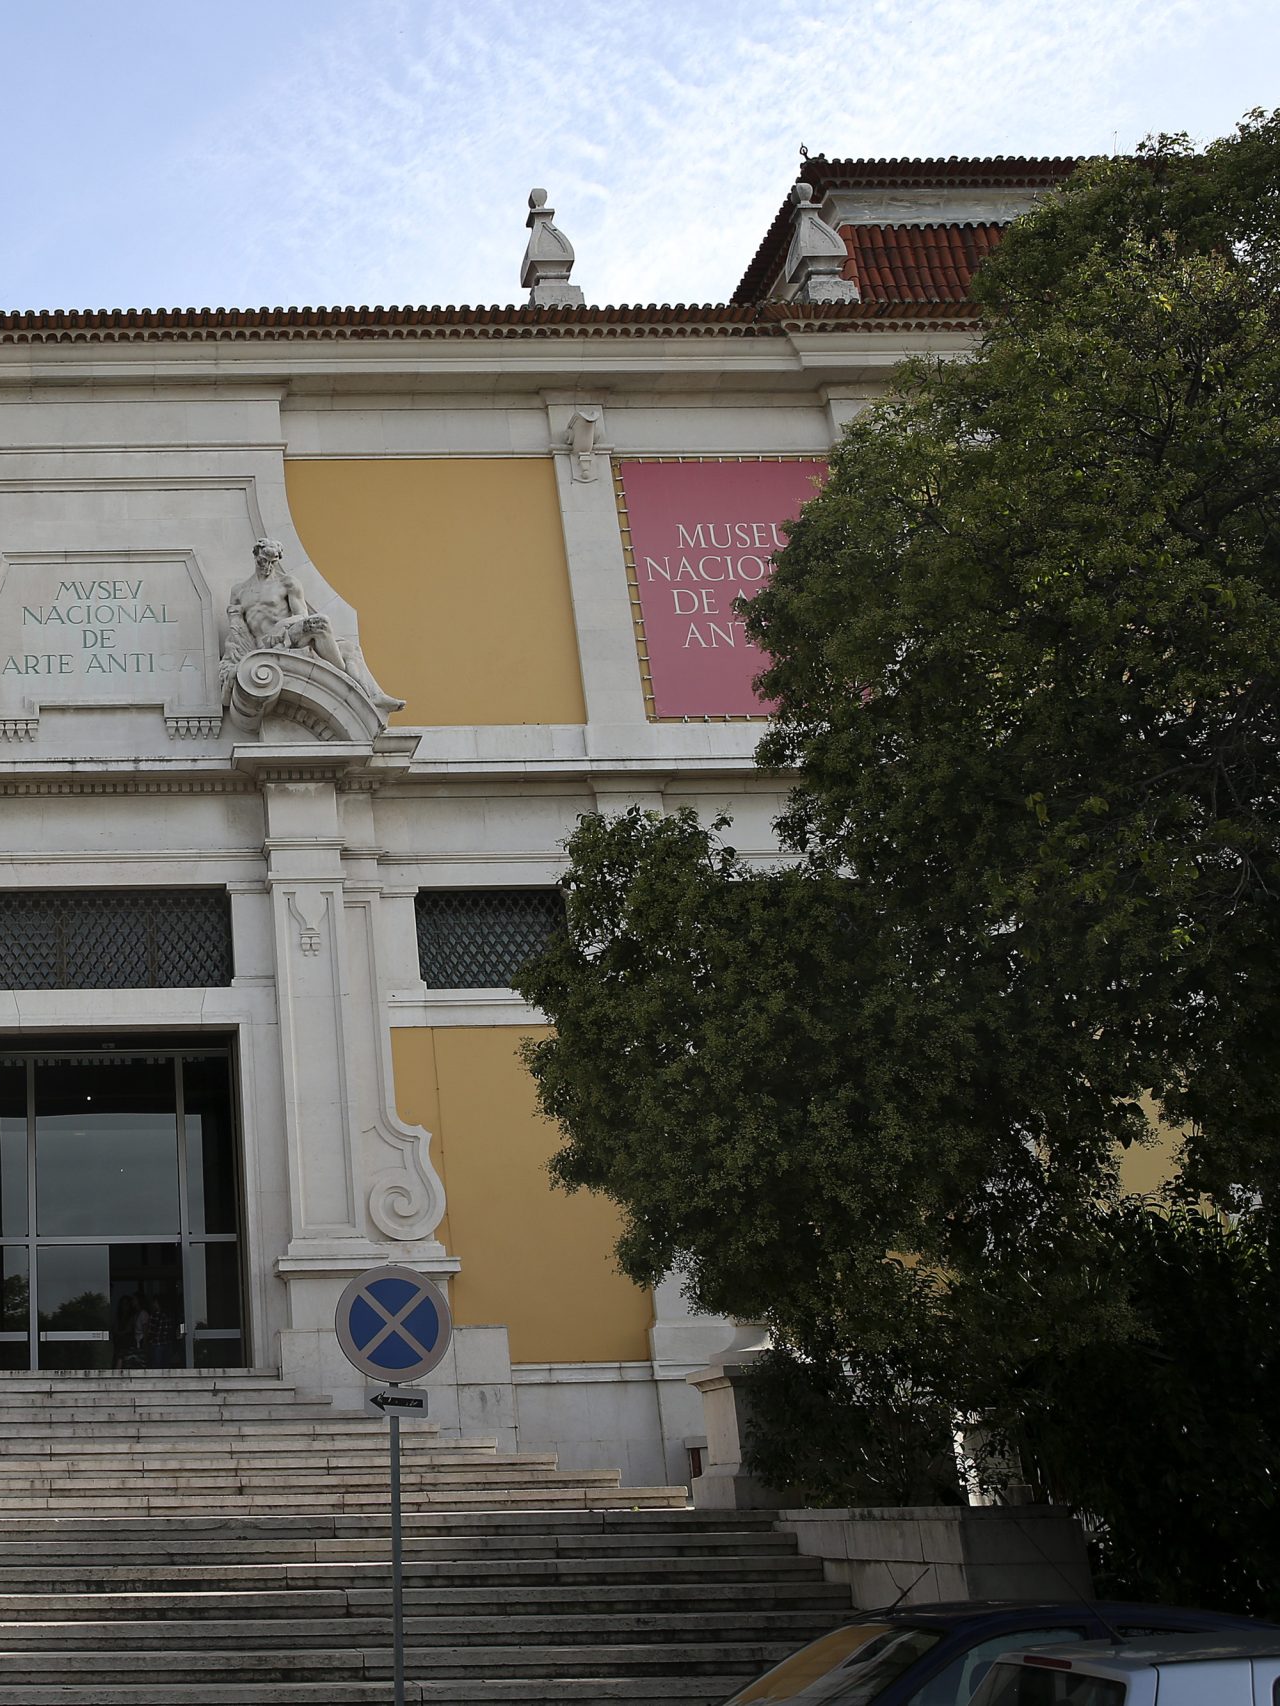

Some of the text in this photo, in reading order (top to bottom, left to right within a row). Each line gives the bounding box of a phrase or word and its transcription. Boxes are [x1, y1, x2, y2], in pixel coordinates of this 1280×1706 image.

[676, 523, 789, 549] MUSEU
[55, 579, 143, 601] MVSEV
[671, 588, 719, 615] DE
[22, 604, 178, 625] NACIONAL
[82, 628, 117, 649] DE
[1, 654, 74, 675] ARTE
